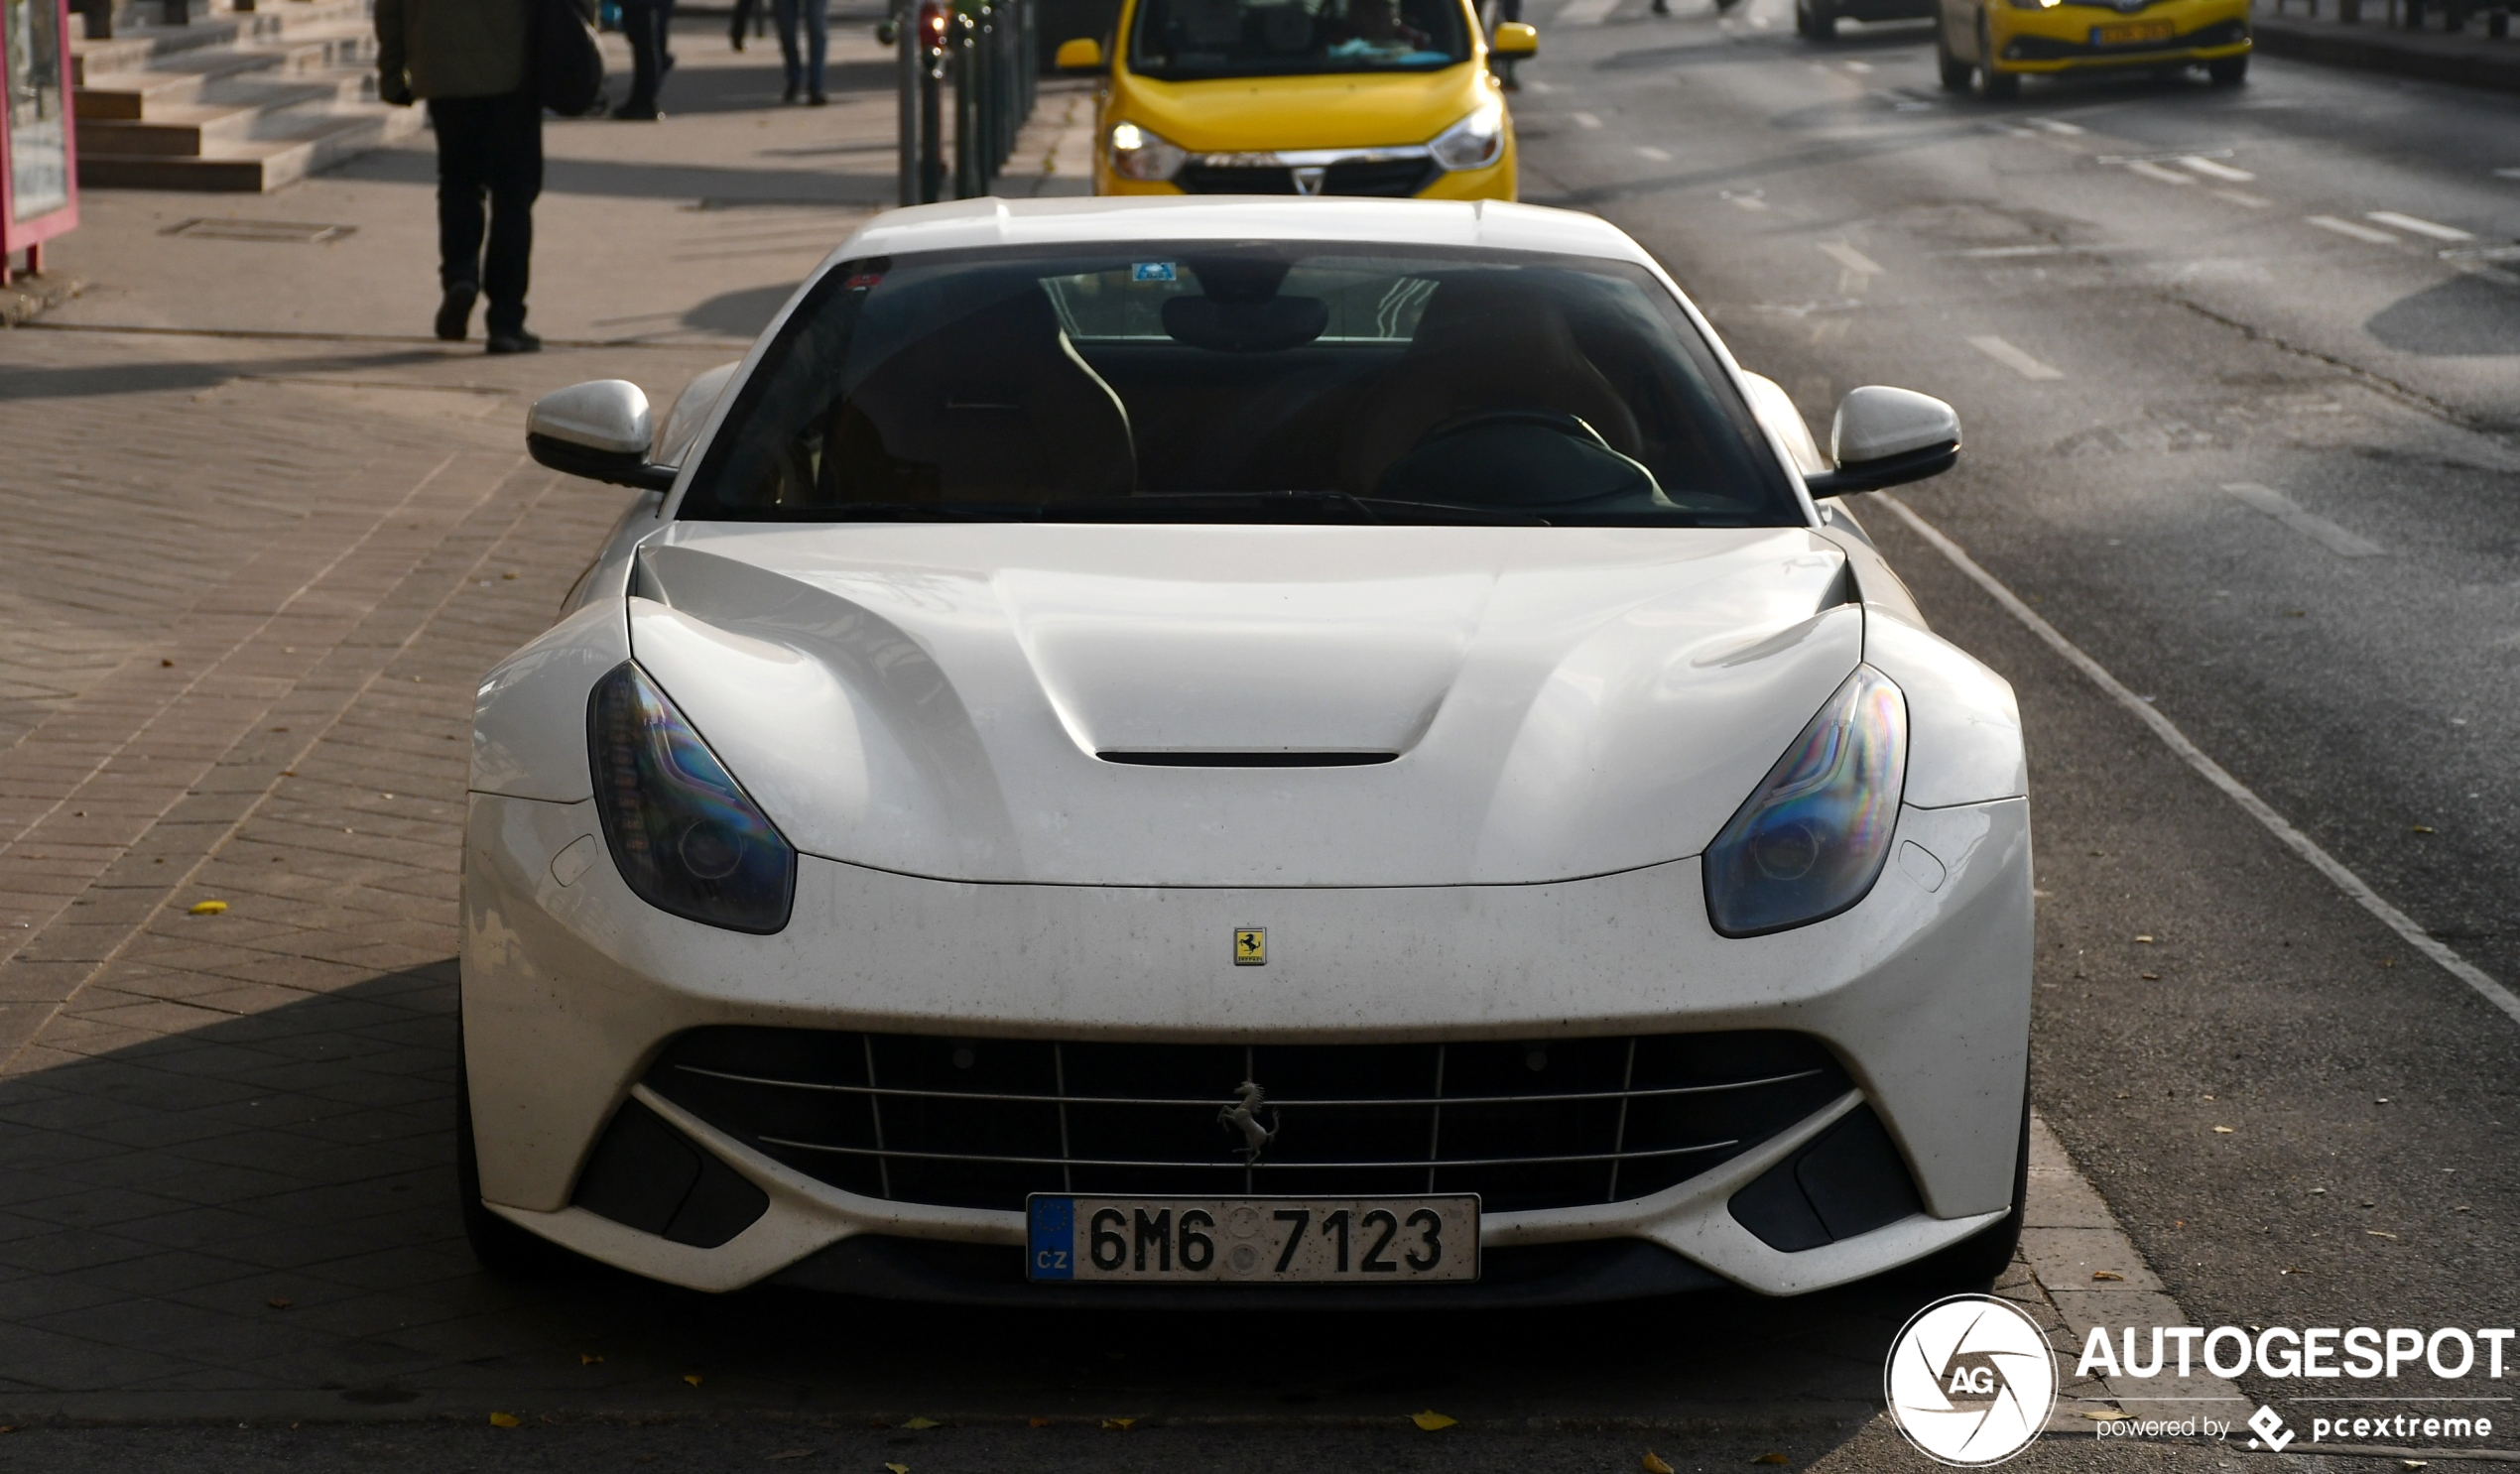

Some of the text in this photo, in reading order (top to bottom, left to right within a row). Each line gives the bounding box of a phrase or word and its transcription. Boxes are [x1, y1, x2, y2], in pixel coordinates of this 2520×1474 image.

[1037, 1251, 1068, 1269] CZ
[1089, 1207, 1443, 1274] 6M6 7123
